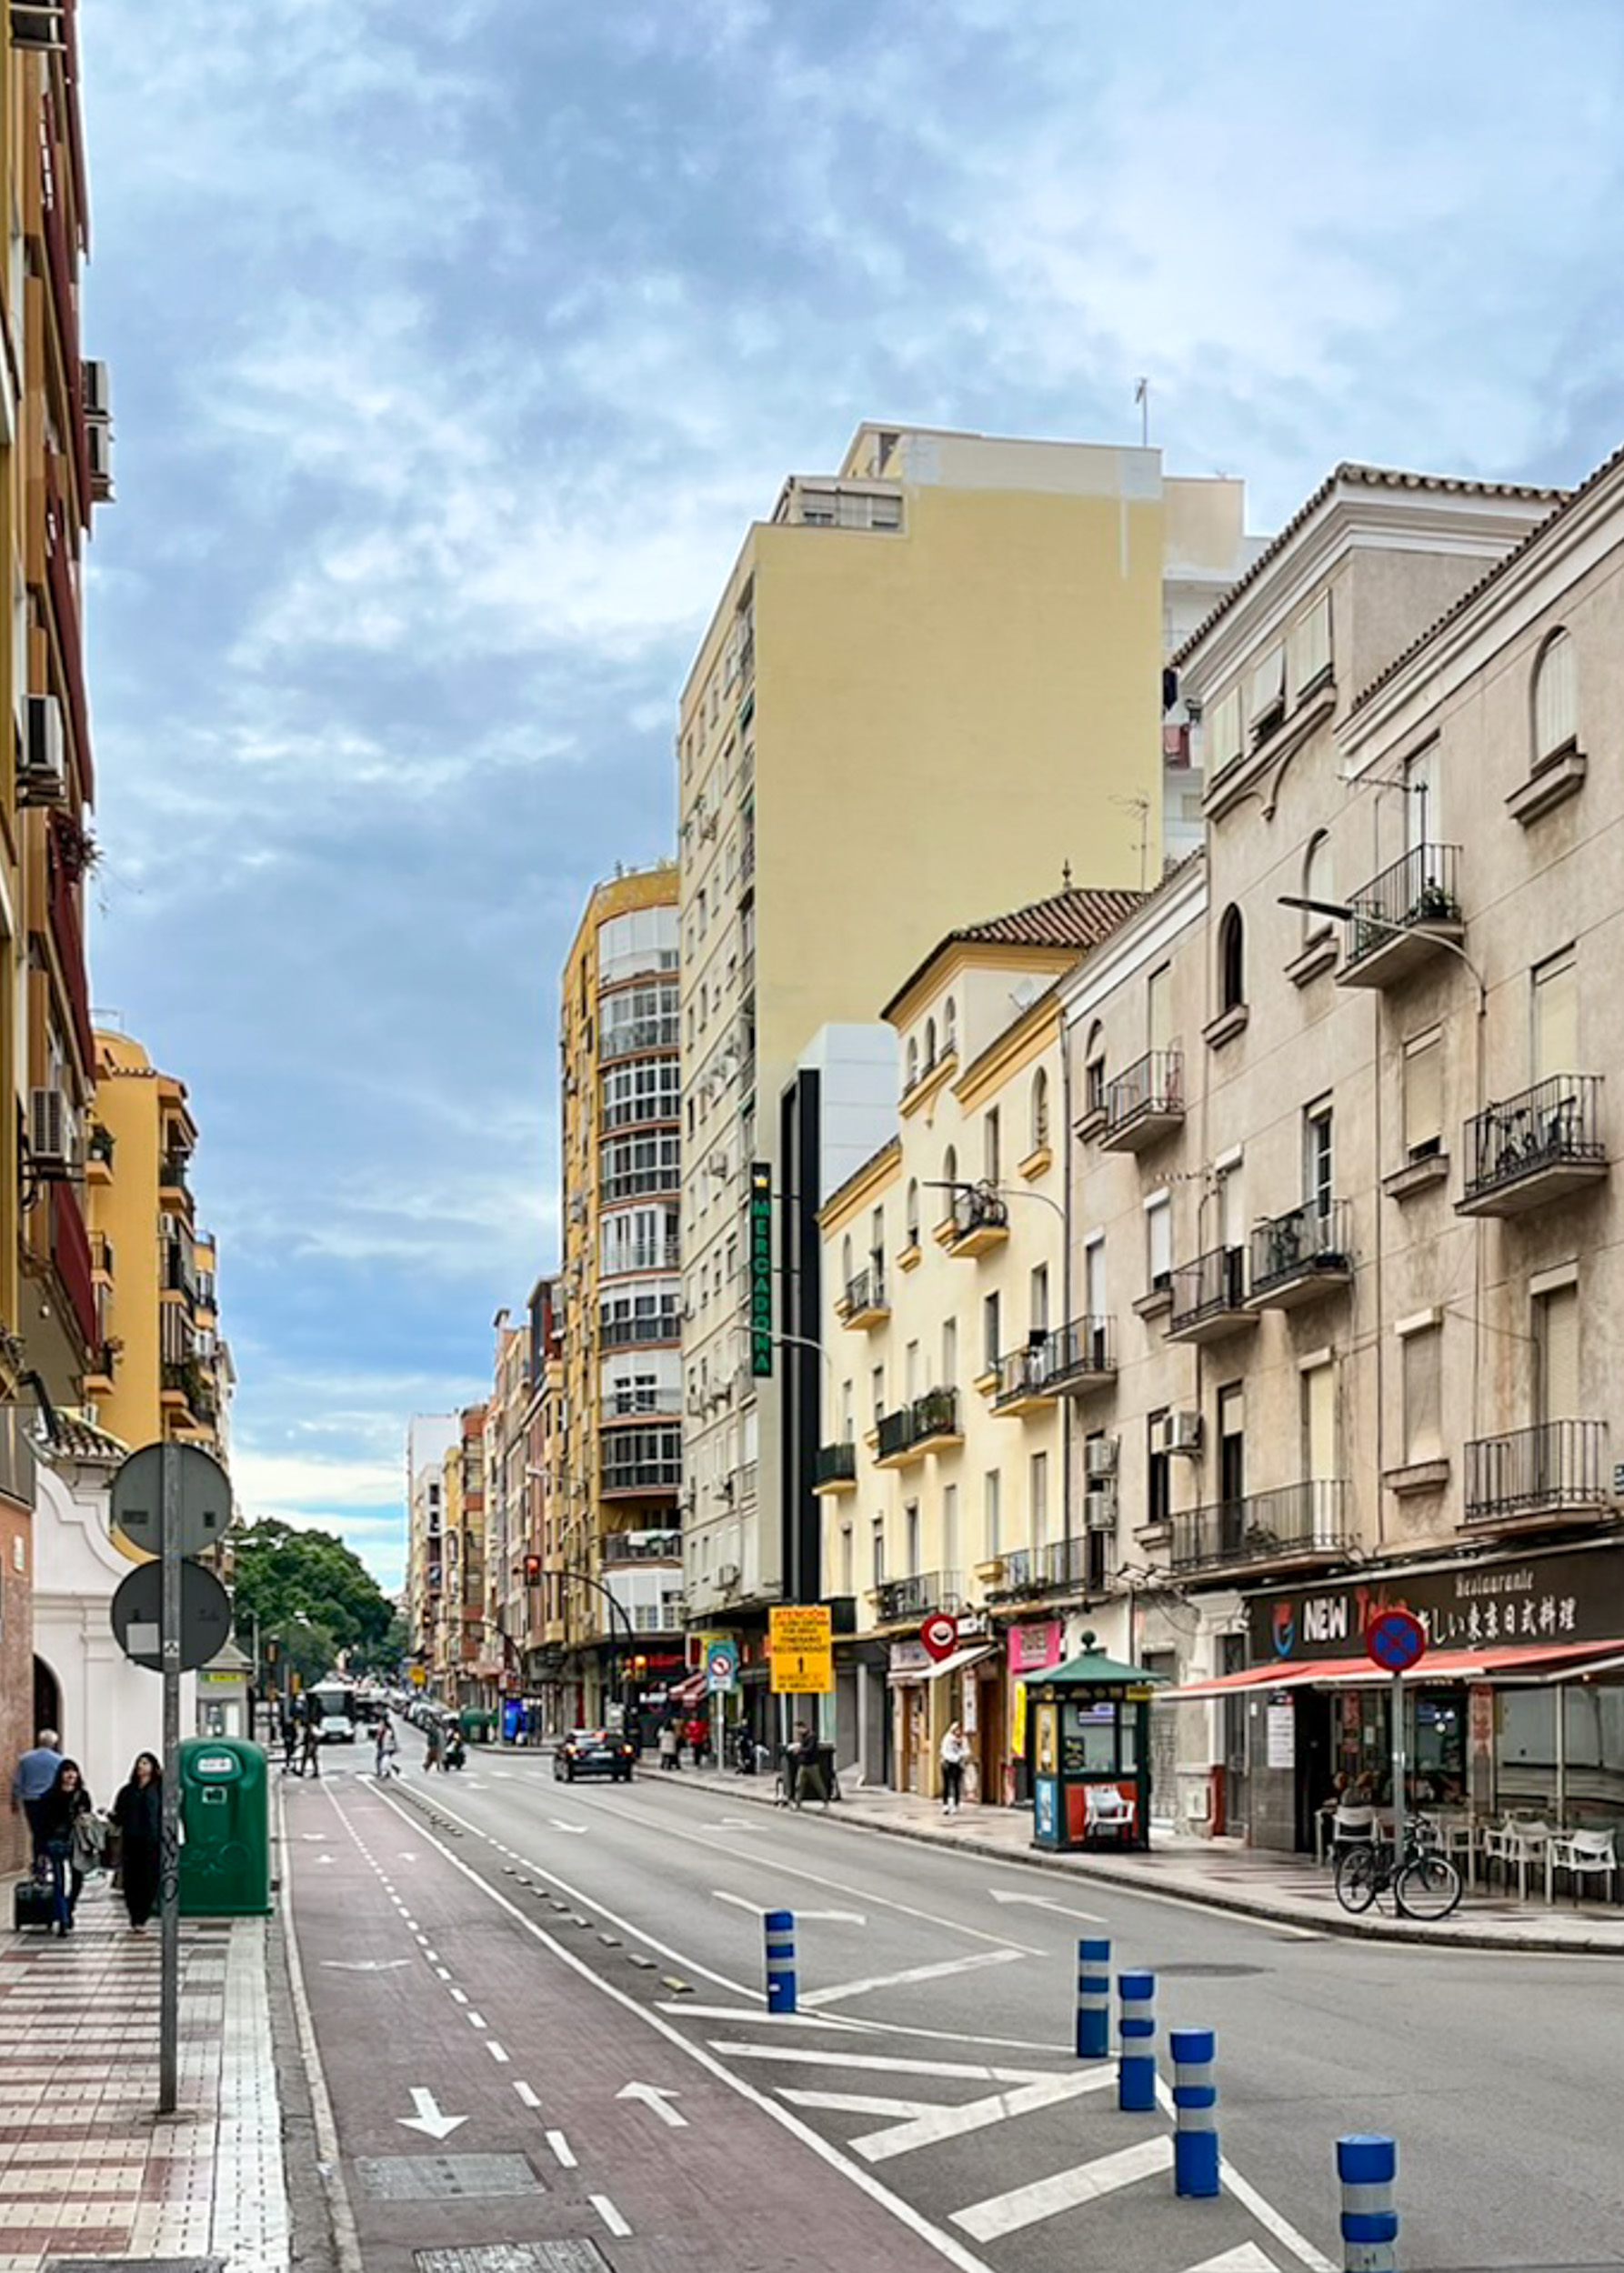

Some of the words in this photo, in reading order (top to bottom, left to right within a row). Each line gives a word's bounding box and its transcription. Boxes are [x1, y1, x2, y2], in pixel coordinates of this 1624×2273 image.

[752, 1200, 769, 1370] MERCADONA
[1456, 1568, 1534, 1597] Restaurante
[1303, 1597, 1348, 1642] NEW
